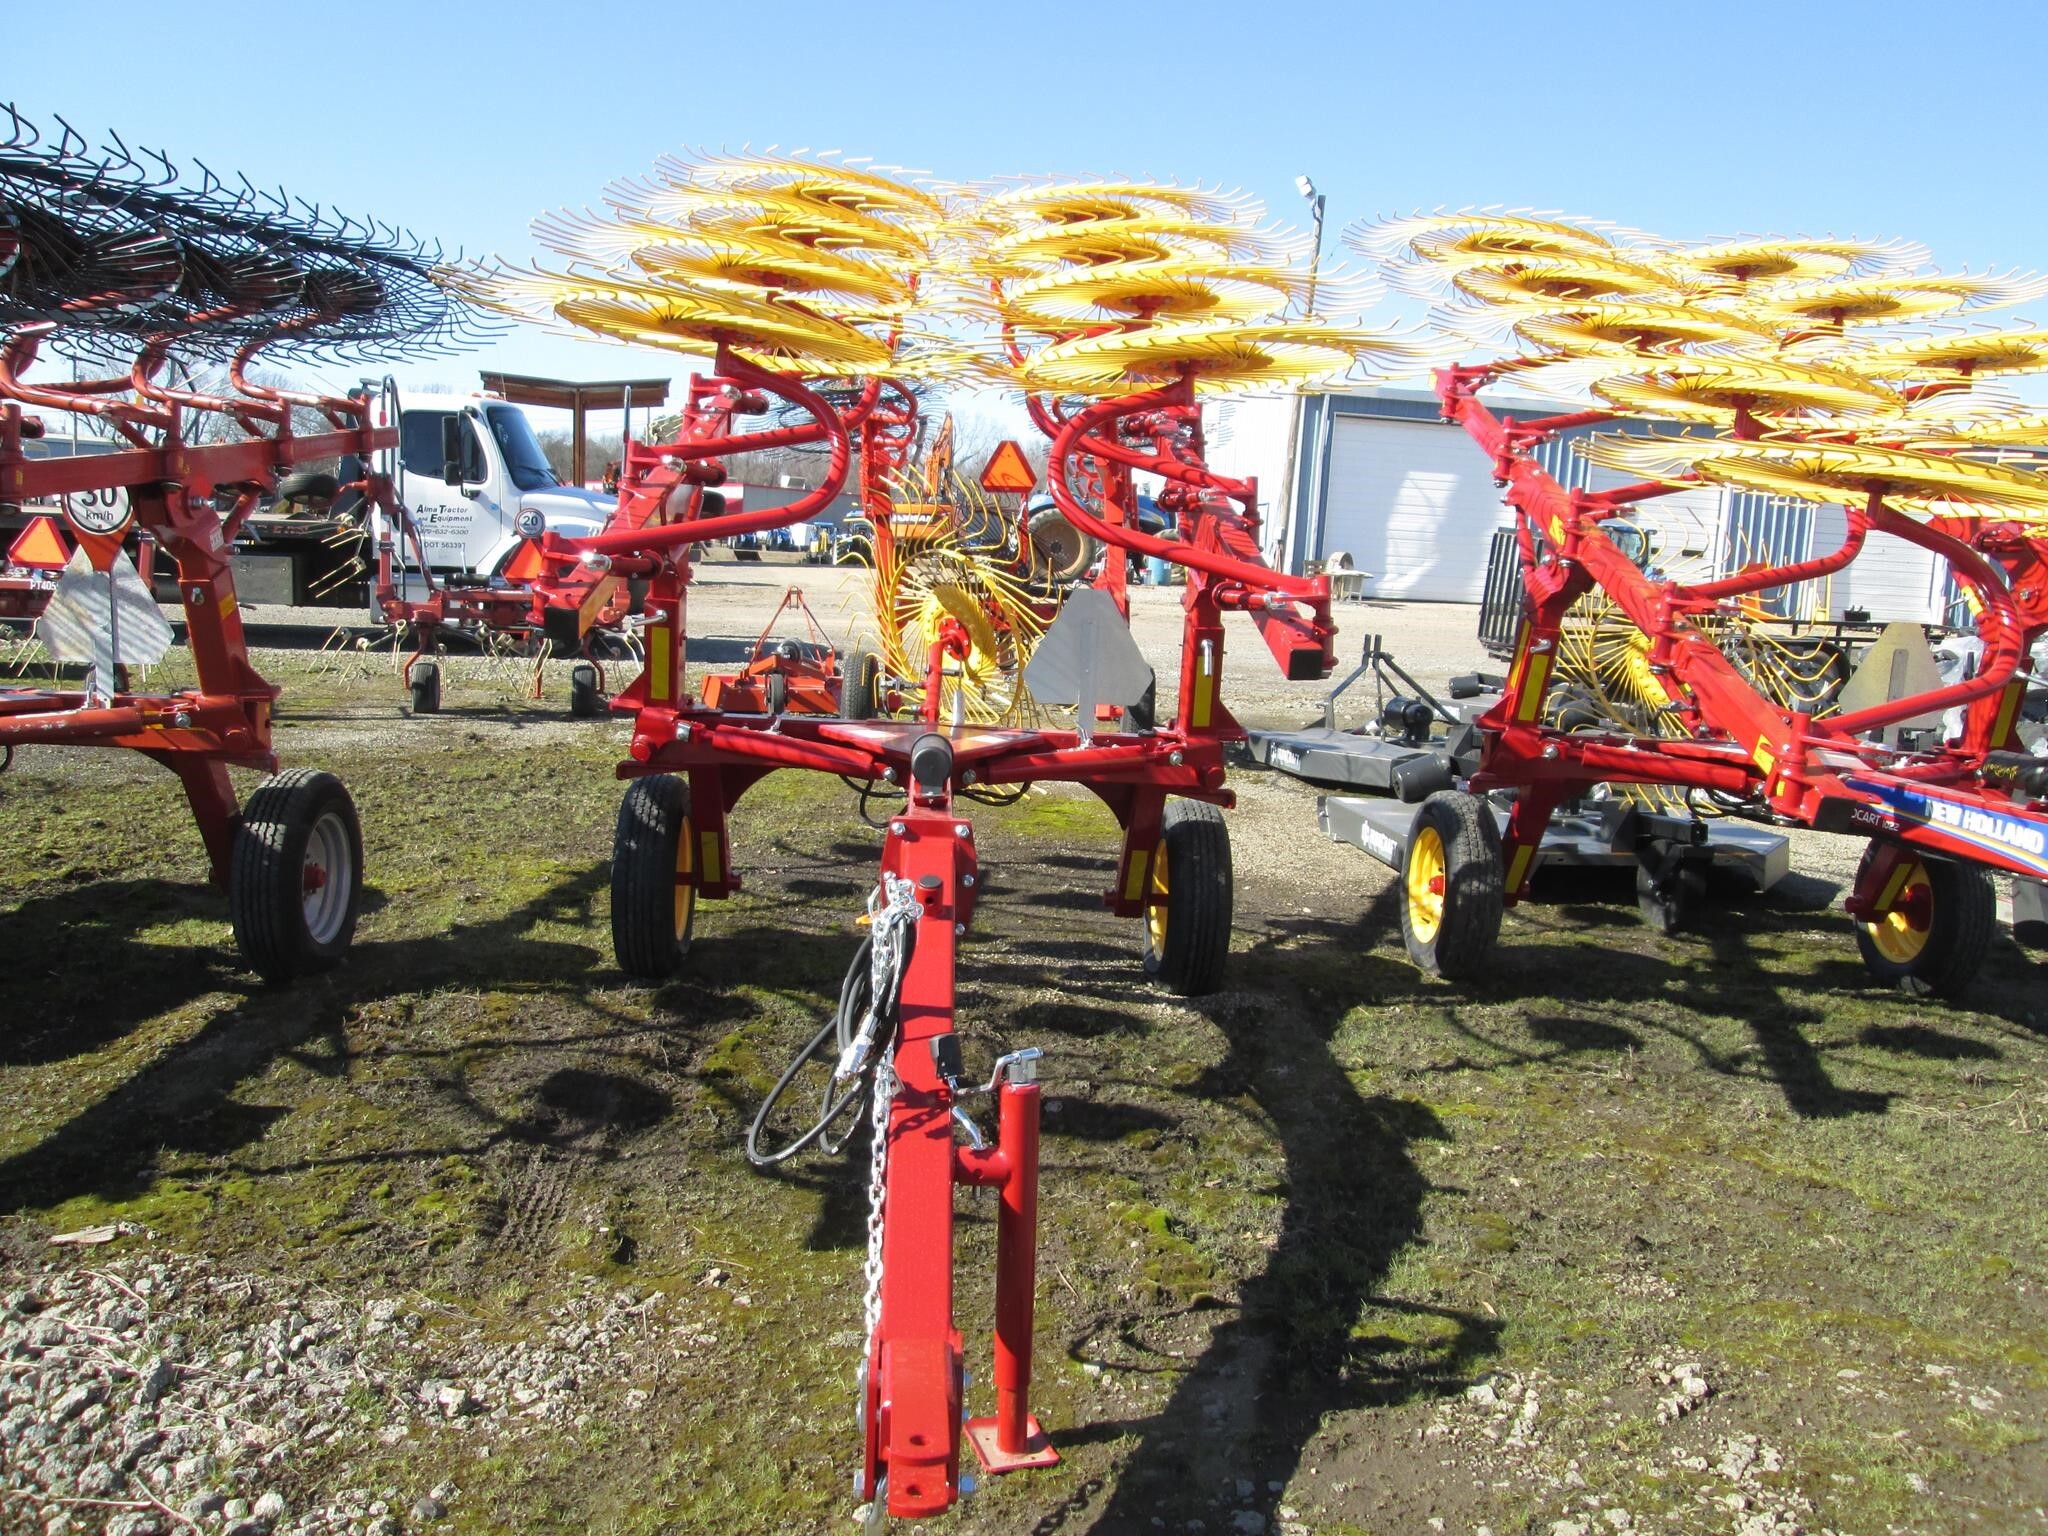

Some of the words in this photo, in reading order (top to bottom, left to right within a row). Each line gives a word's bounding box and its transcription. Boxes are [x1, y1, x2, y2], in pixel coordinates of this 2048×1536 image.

[416, 504, 438, 514] Alma
[439, 505, 468, 514] Tractor
[85, 509, 114, 521] km/h
[430, 513, 473, 523] Equipment
[522, 515, 538, 526] 20
[1925, 799, 1963, 826] NEW
[1962, 808, 2045, 854] HOLLAND
